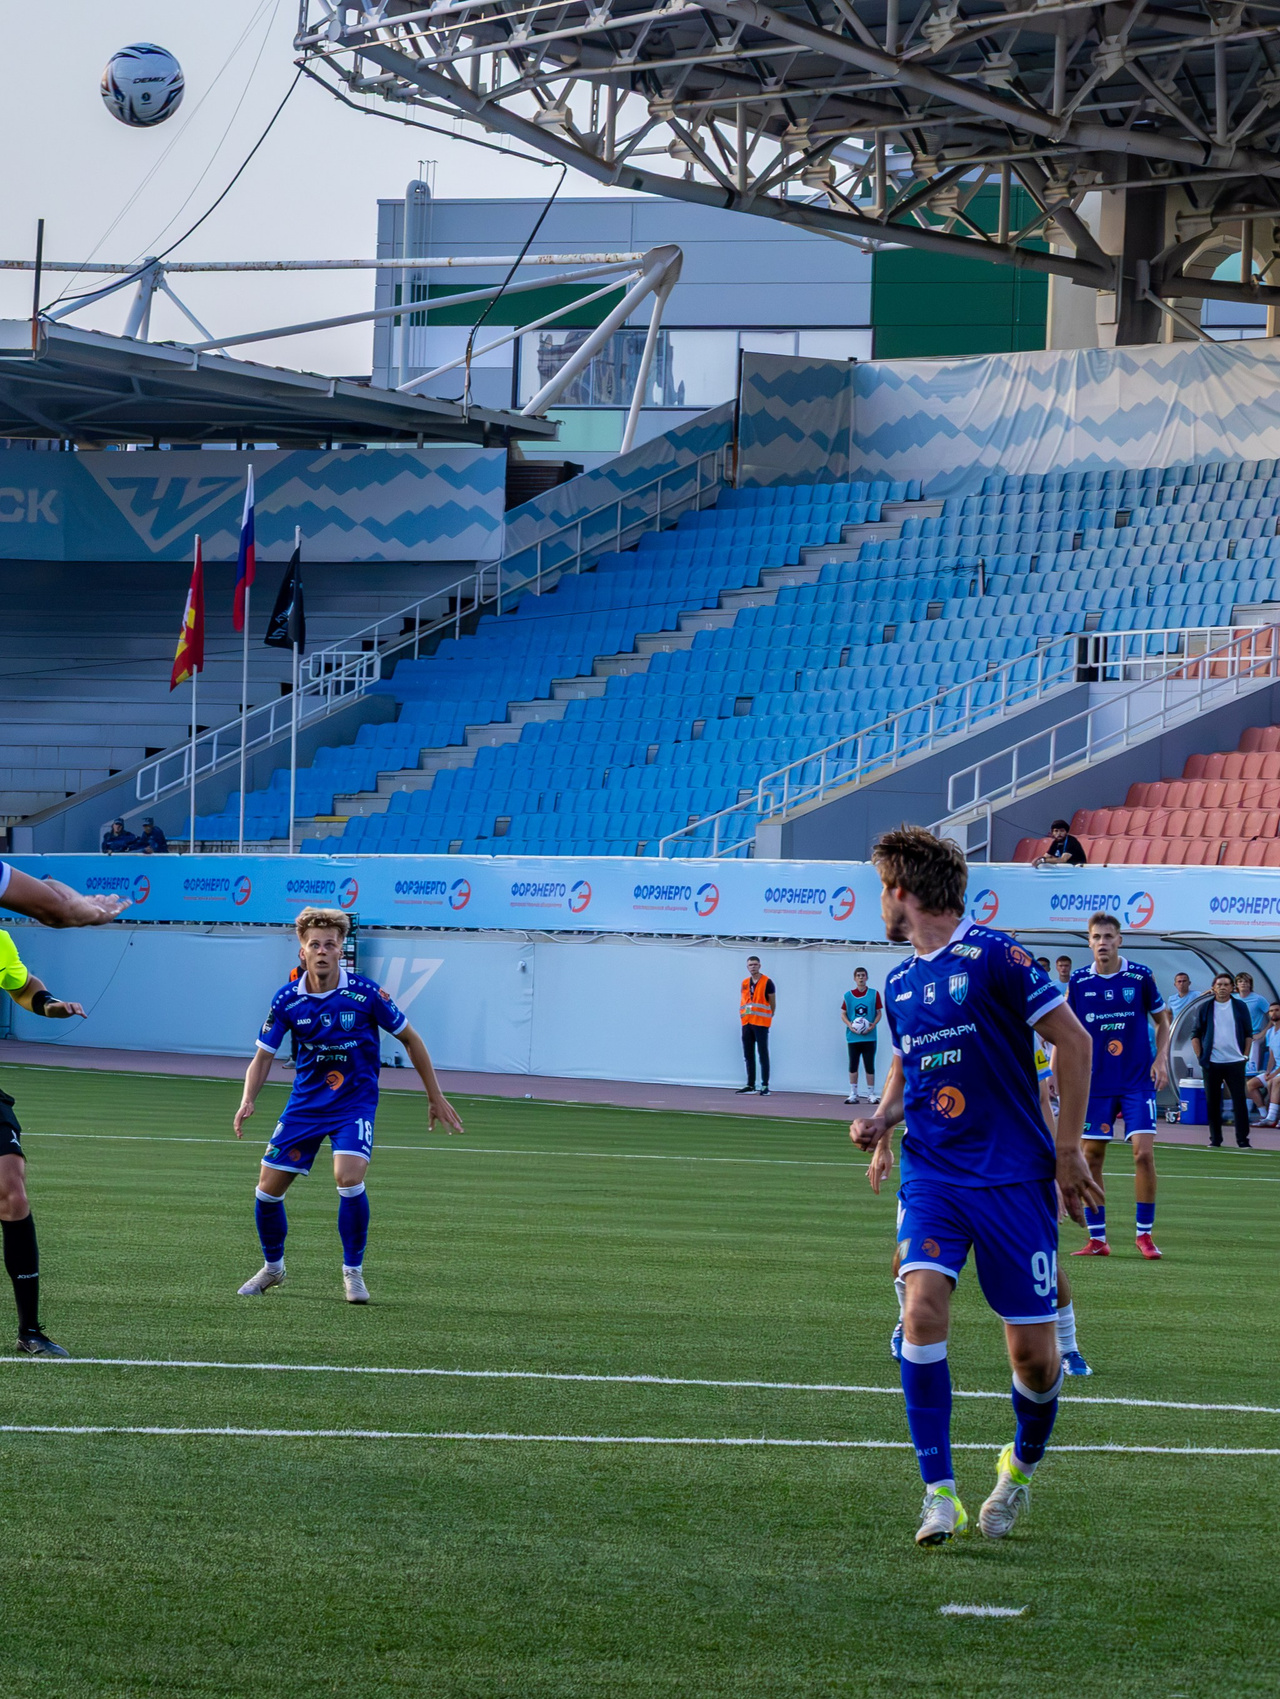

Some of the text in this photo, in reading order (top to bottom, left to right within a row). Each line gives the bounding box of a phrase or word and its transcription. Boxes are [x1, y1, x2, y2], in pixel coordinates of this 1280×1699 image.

[86, 877, 130, 891] ФОРЭНЕРГО
[183, 878, 230, 892] ФОРЭНЕРГО
[286, 879, 336, 894] ФОРЭНЕРГО
[395, 880, 447, 895] ФОРЭНЕРГО
[511, 882, 566, 898] ФОРЭНЕРГО
[633, 884, 691, 900] ФОРЭНЕРГО
[764, 887, 826, 904] ФОРЭНЕРГО
[1050, 894, 1121, 912] ФОРЭНЕРГО
[951, 943, 982, 960] PARI
[340, 989, 368, 1003] PARI
[1100, 1022, 1125, 1031] PARI
[912, 1023, 977, 1047] НИЖФАРМ
[921, 1049, 962, 1070] PARI
[355, 1118, 373, 1146] 18
[1031, 1250, 1058, 1297] 94
